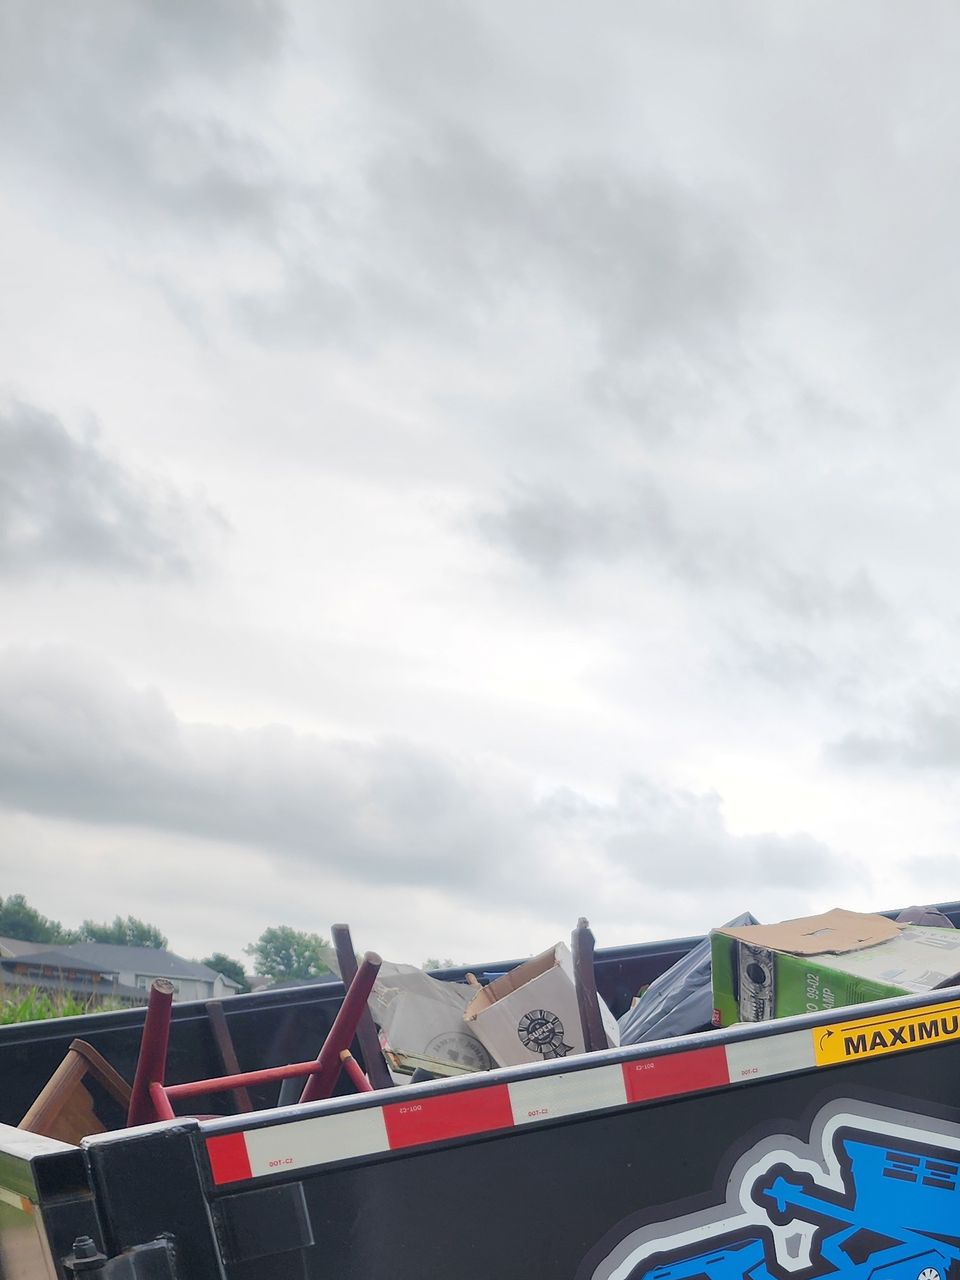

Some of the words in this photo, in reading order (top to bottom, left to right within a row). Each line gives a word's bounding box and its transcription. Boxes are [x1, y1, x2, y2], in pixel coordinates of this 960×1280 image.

[807, 973, 820, 999] 99-02
[822, 988, 835, 1009] AMP
[528, 1022, 554, 1041] SUPER
[268, 1157, 294, 1168] DOT-C2
